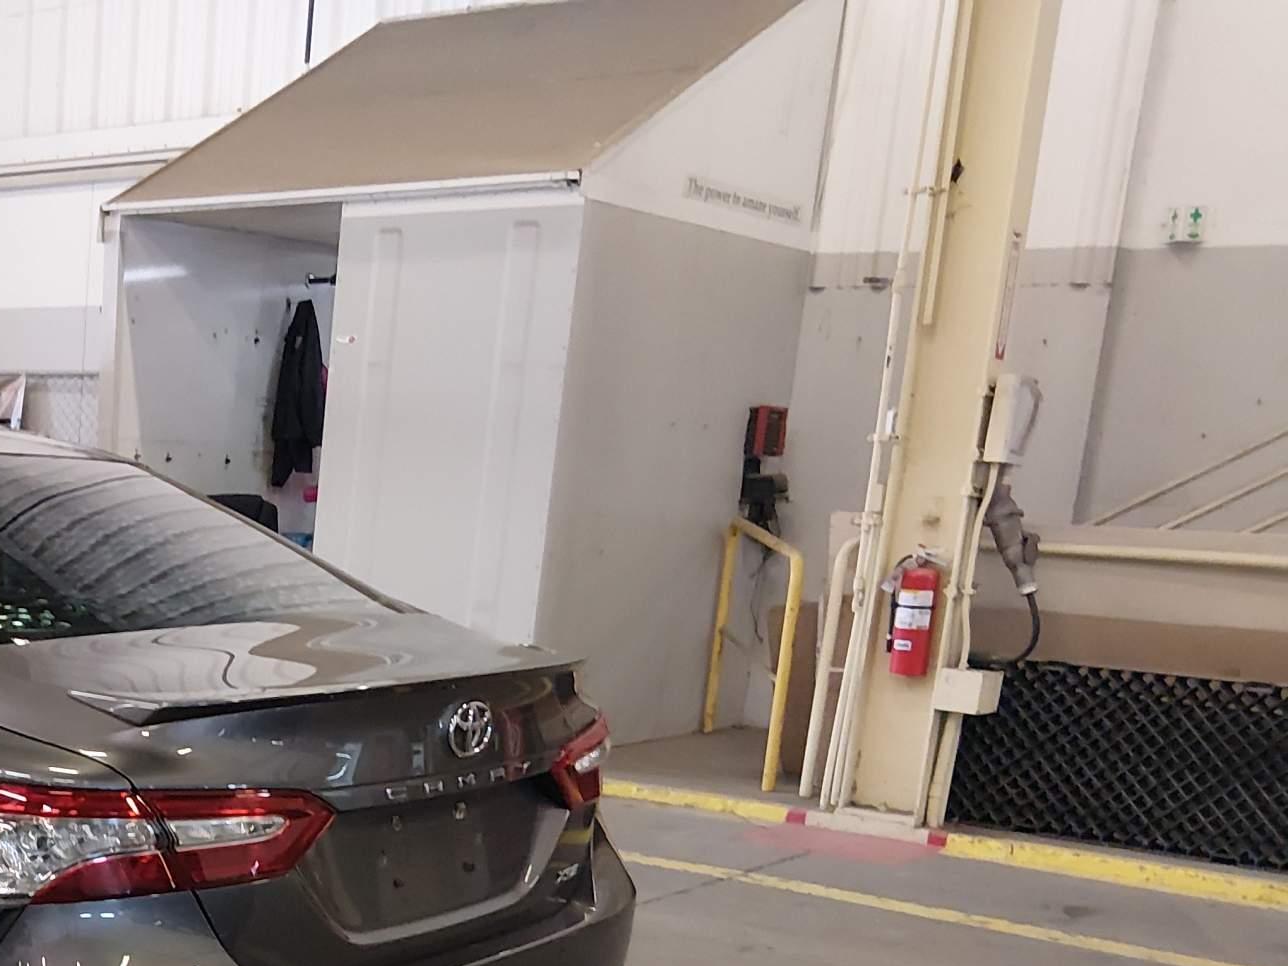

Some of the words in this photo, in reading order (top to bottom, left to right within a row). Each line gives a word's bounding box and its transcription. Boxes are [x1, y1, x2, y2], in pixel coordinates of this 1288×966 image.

[688, 177, 705, 197] The
[704, 186, 731, 204] power
[732, 191, 742, 206] to
[385, 760, 531, 801] CAMRY
